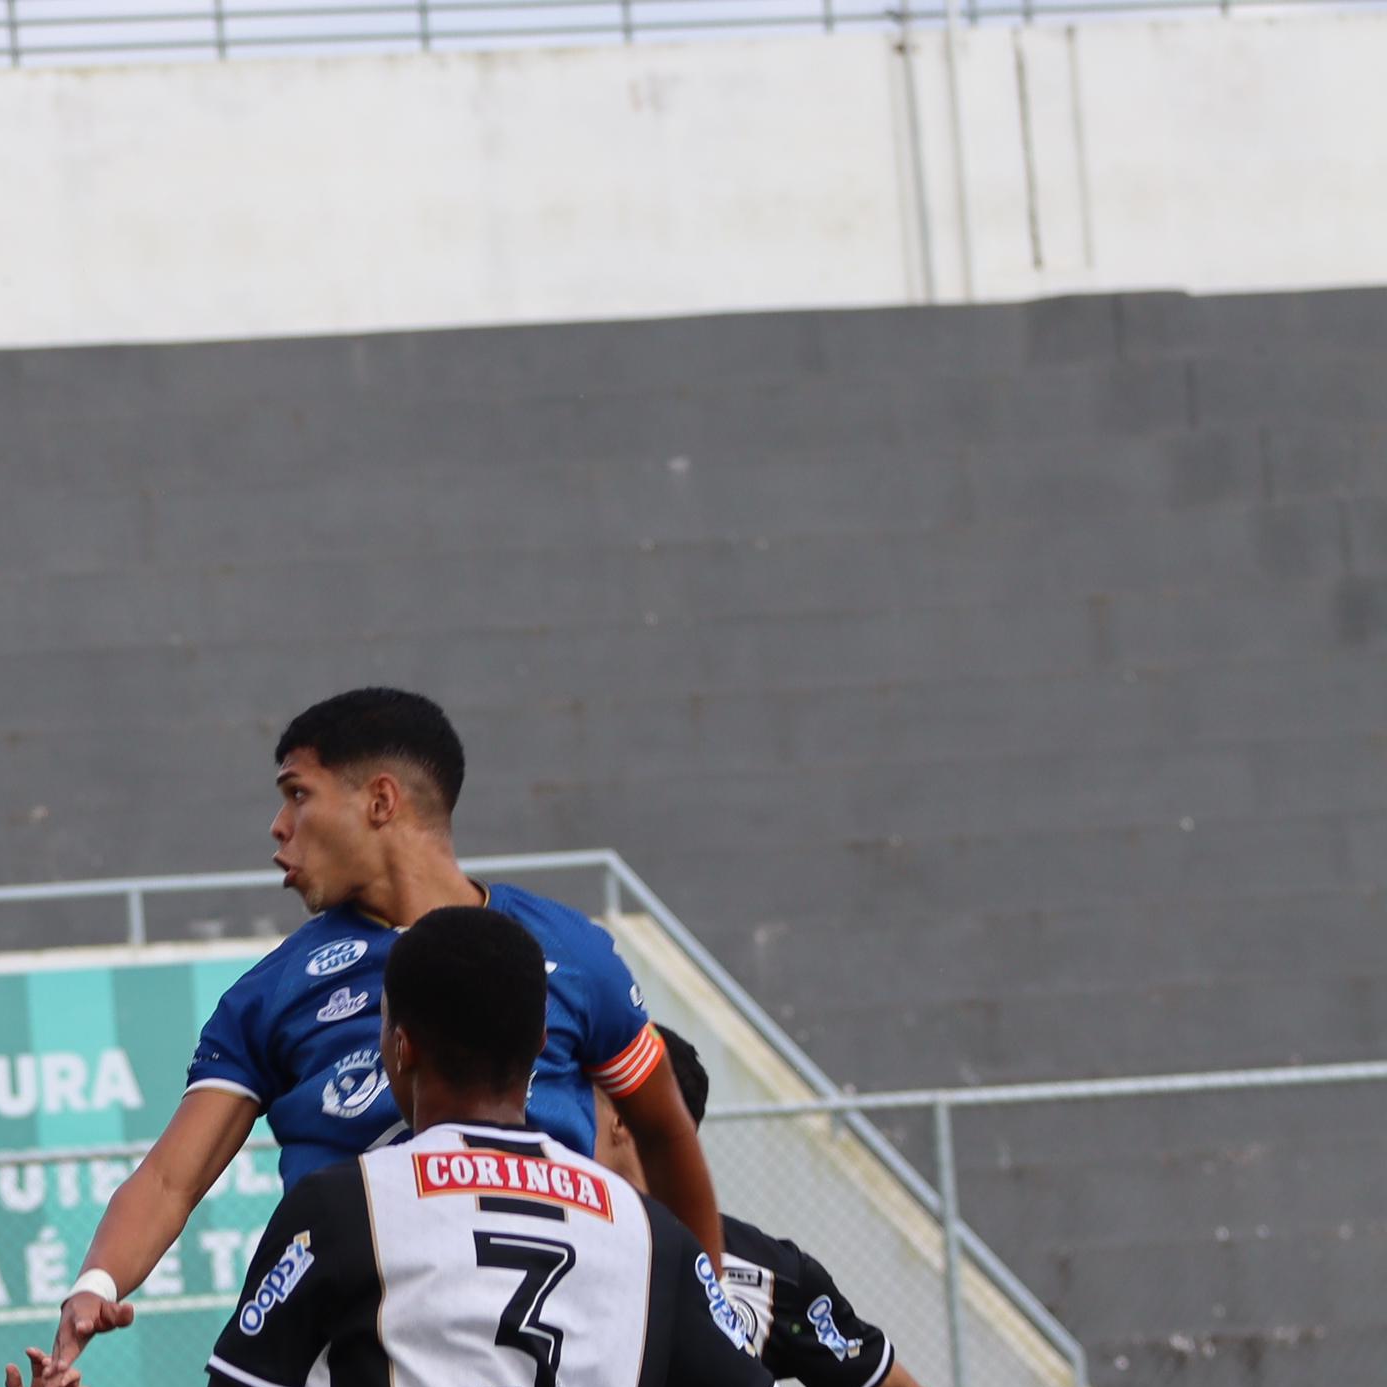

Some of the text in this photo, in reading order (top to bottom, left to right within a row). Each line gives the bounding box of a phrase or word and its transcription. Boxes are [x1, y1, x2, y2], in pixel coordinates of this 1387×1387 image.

[426, 1155, 602, 1211] CORINGA
[24, 1226, 70, 1303] É
[241, 1258, 296, 1331] Oops
